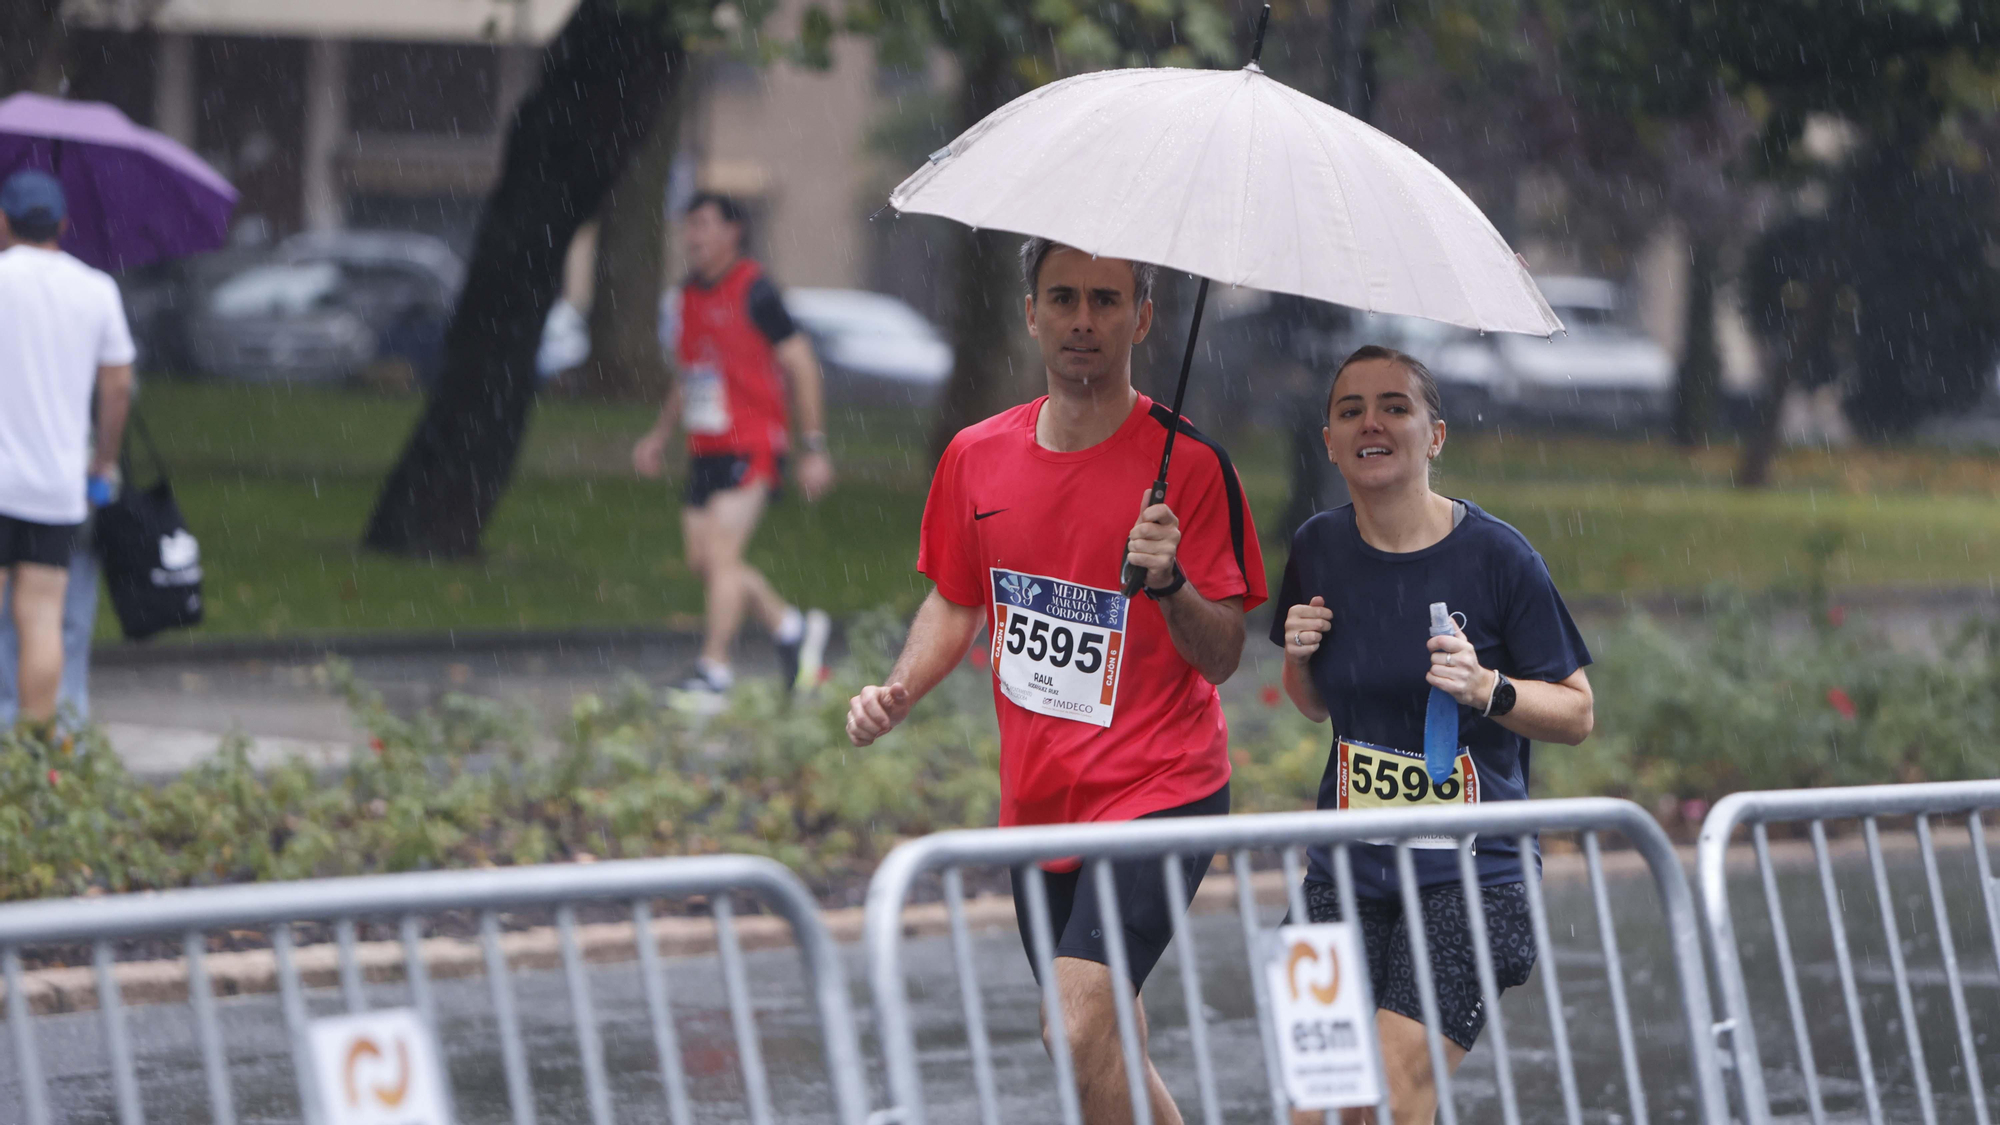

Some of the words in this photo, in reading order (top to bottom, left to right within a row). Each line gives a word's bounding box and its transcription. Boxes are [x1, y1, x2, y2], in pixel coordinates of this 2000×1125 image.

[1009, 585, 1033, 607] 39
[1052, 582, 1097, 604] MEDIA
[1108, 595, 1120, 625] 2025
[1006, 612, 1104, 674] 5595
[1033, 672, 1054, 687] RAUL
[1105, 657, 1117, 687] CAJÓN
[1053, 699, 1094, 714] IMDECO
[1351, 753, 1460, 802] 5596
